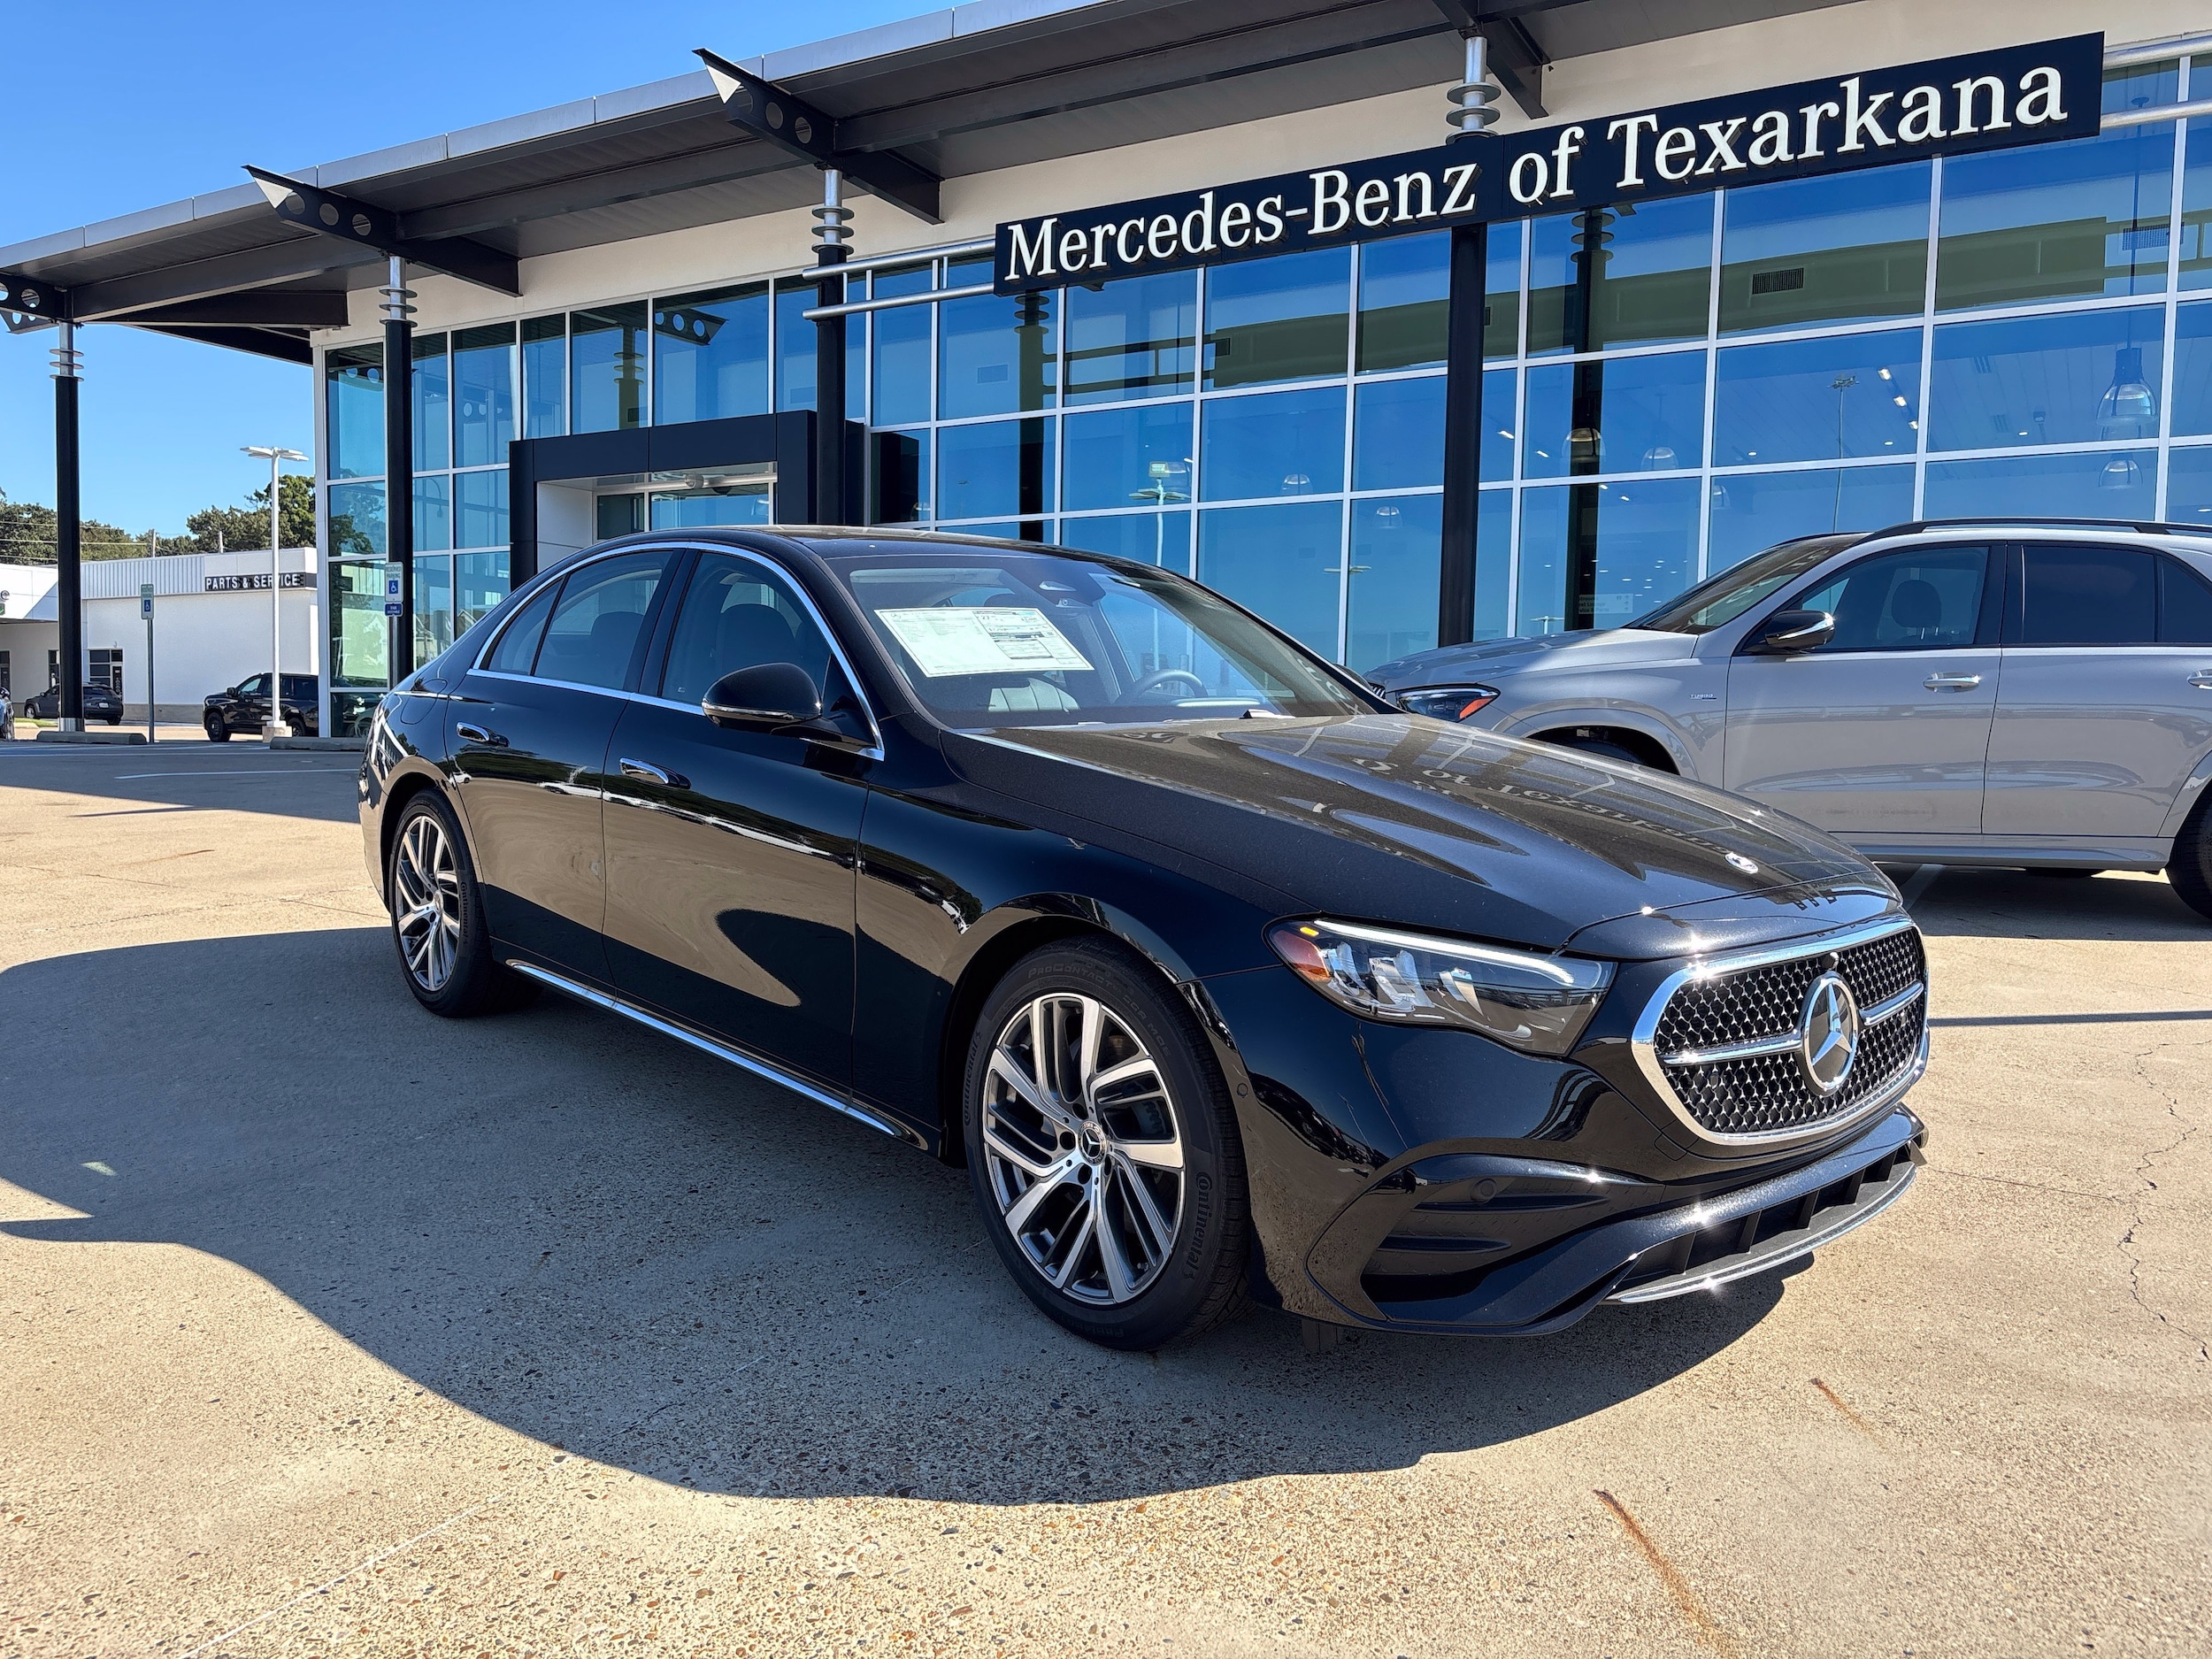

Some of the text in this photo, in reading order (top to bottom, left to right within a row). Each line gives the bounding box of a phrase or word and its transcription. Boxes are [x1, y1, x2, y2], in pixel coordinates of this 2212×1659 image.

[1004, 66, 2068, 282] Mercedes-Benz of Texarkana
[206, 576, 238, 590] PARTS
[242, 577, 249, 588] &
[1186, 1171, 1213, 1271] Continental
